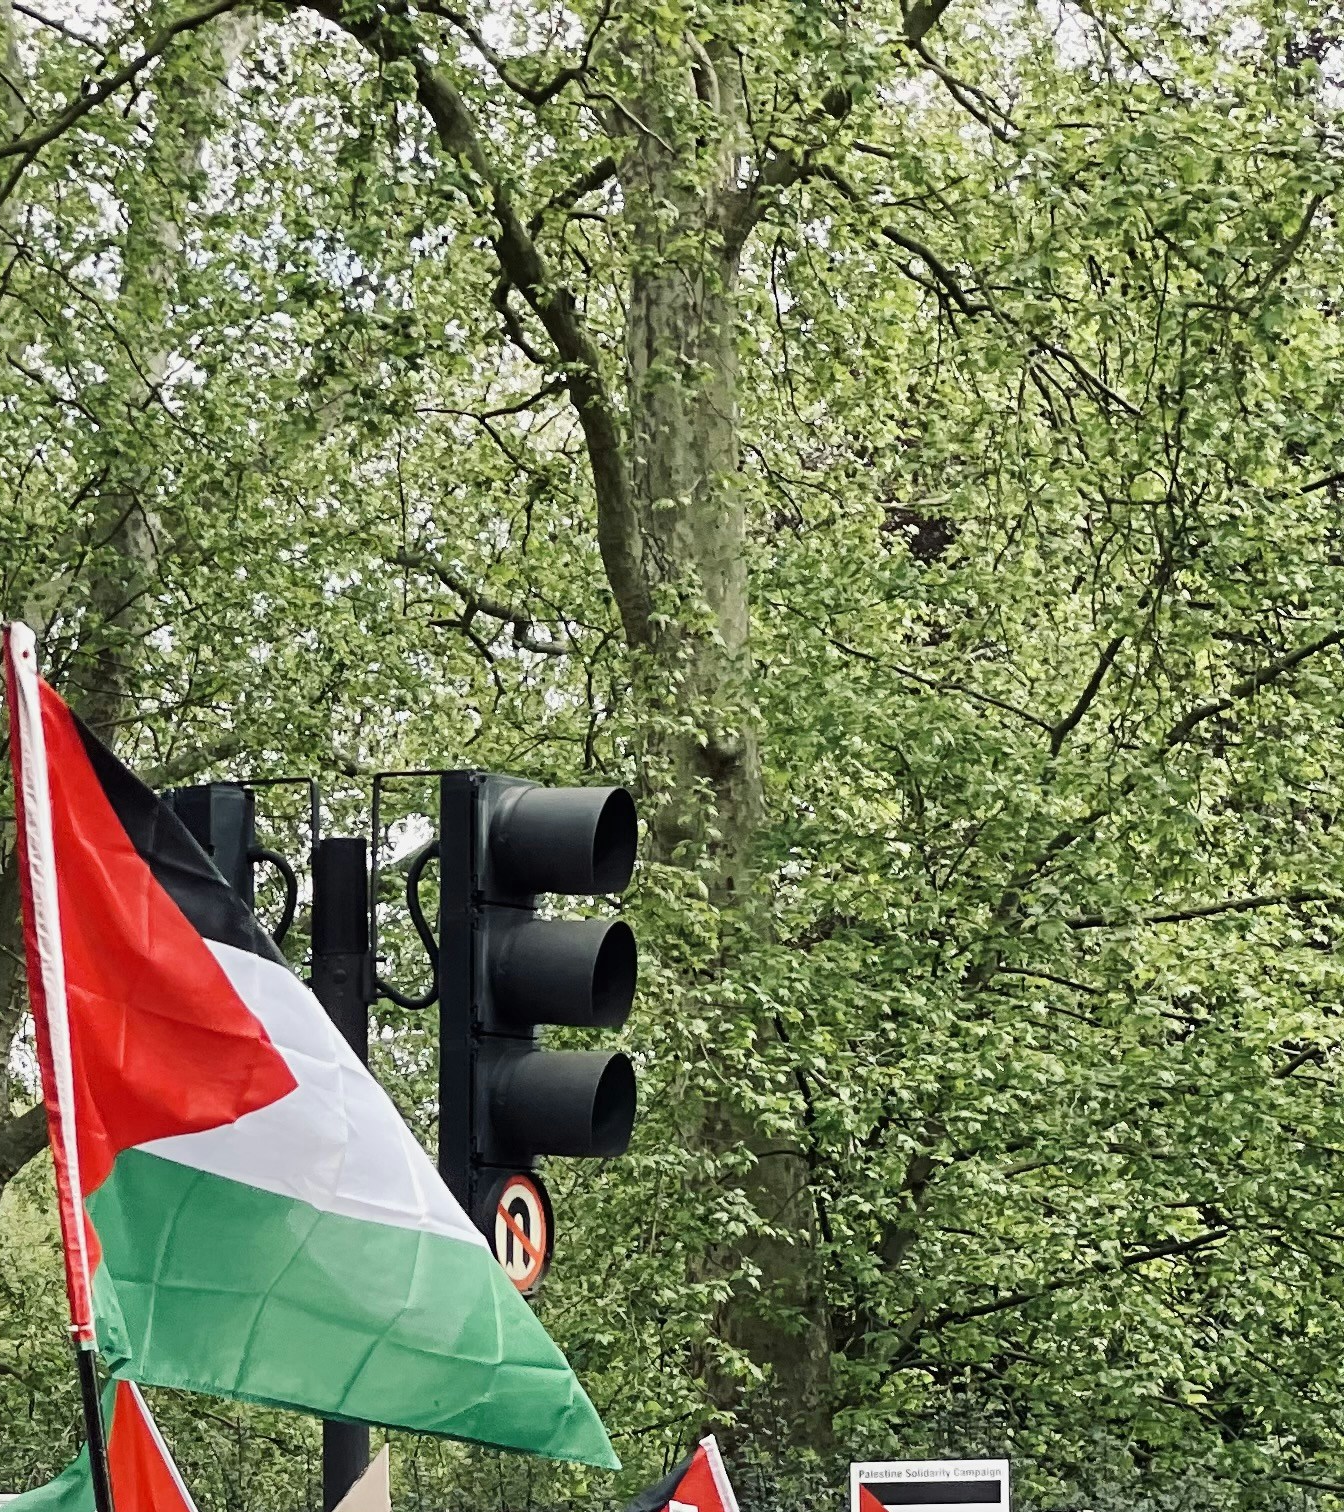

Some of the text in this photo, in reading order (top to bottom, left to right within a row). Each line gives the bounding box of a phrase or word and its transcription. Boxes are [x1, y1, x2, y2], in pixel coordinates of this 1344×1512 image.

[859, 1468, 1002, 1479] Palestine Solidarity Campaign
